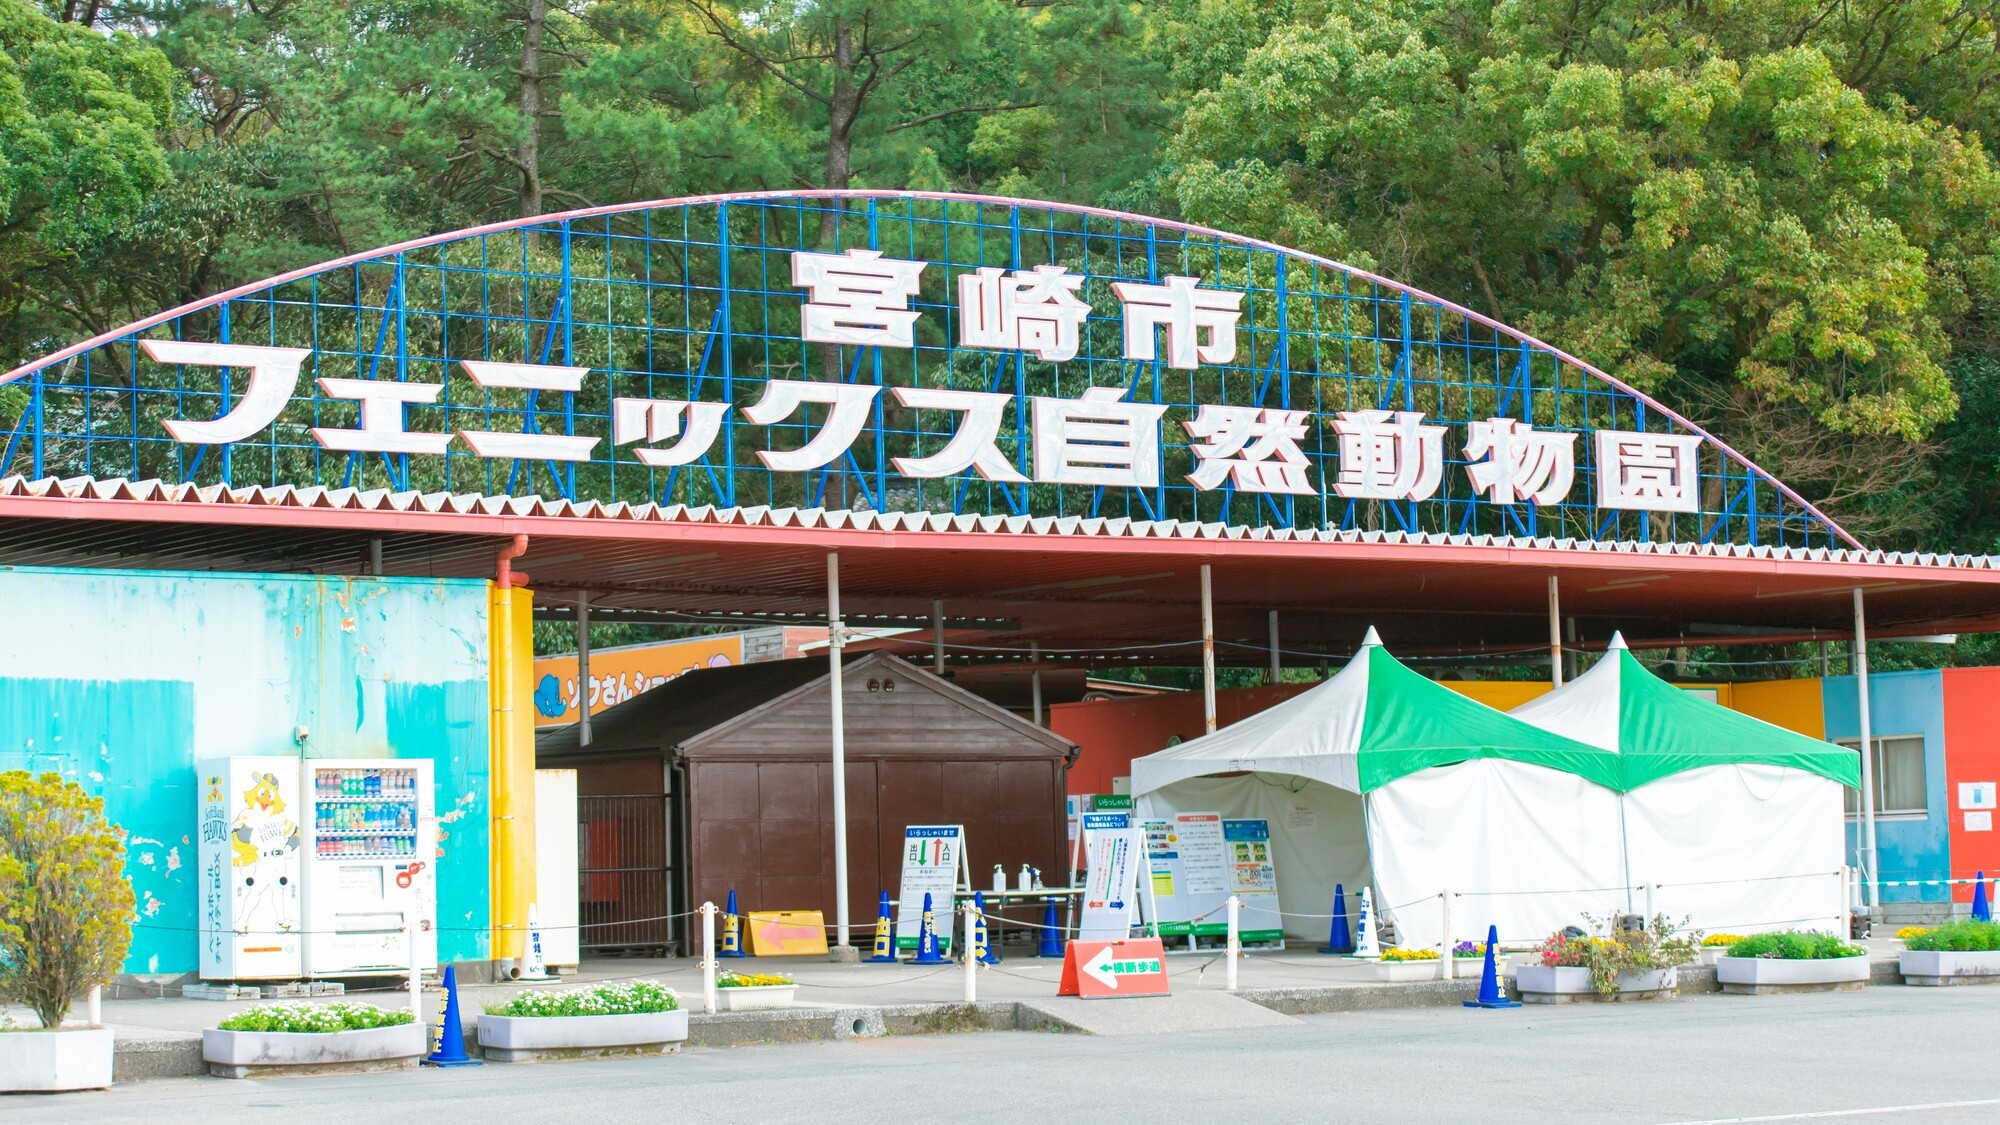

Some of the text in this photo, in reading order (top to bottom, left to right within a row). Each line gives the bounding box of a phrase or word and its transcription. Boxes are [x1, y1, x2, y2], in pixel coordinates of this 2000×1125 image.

[791, 249, 1245, 370] 宮崎市
[139, 338, 1702, 514] フェニックス自然動物園
[203, 819, 228, 843] HAWKS
[909, 843, 918, 861] 出口
[942, 843, 951, 861] 入口
[1112, 961, 1161, 974] 横断歩道
